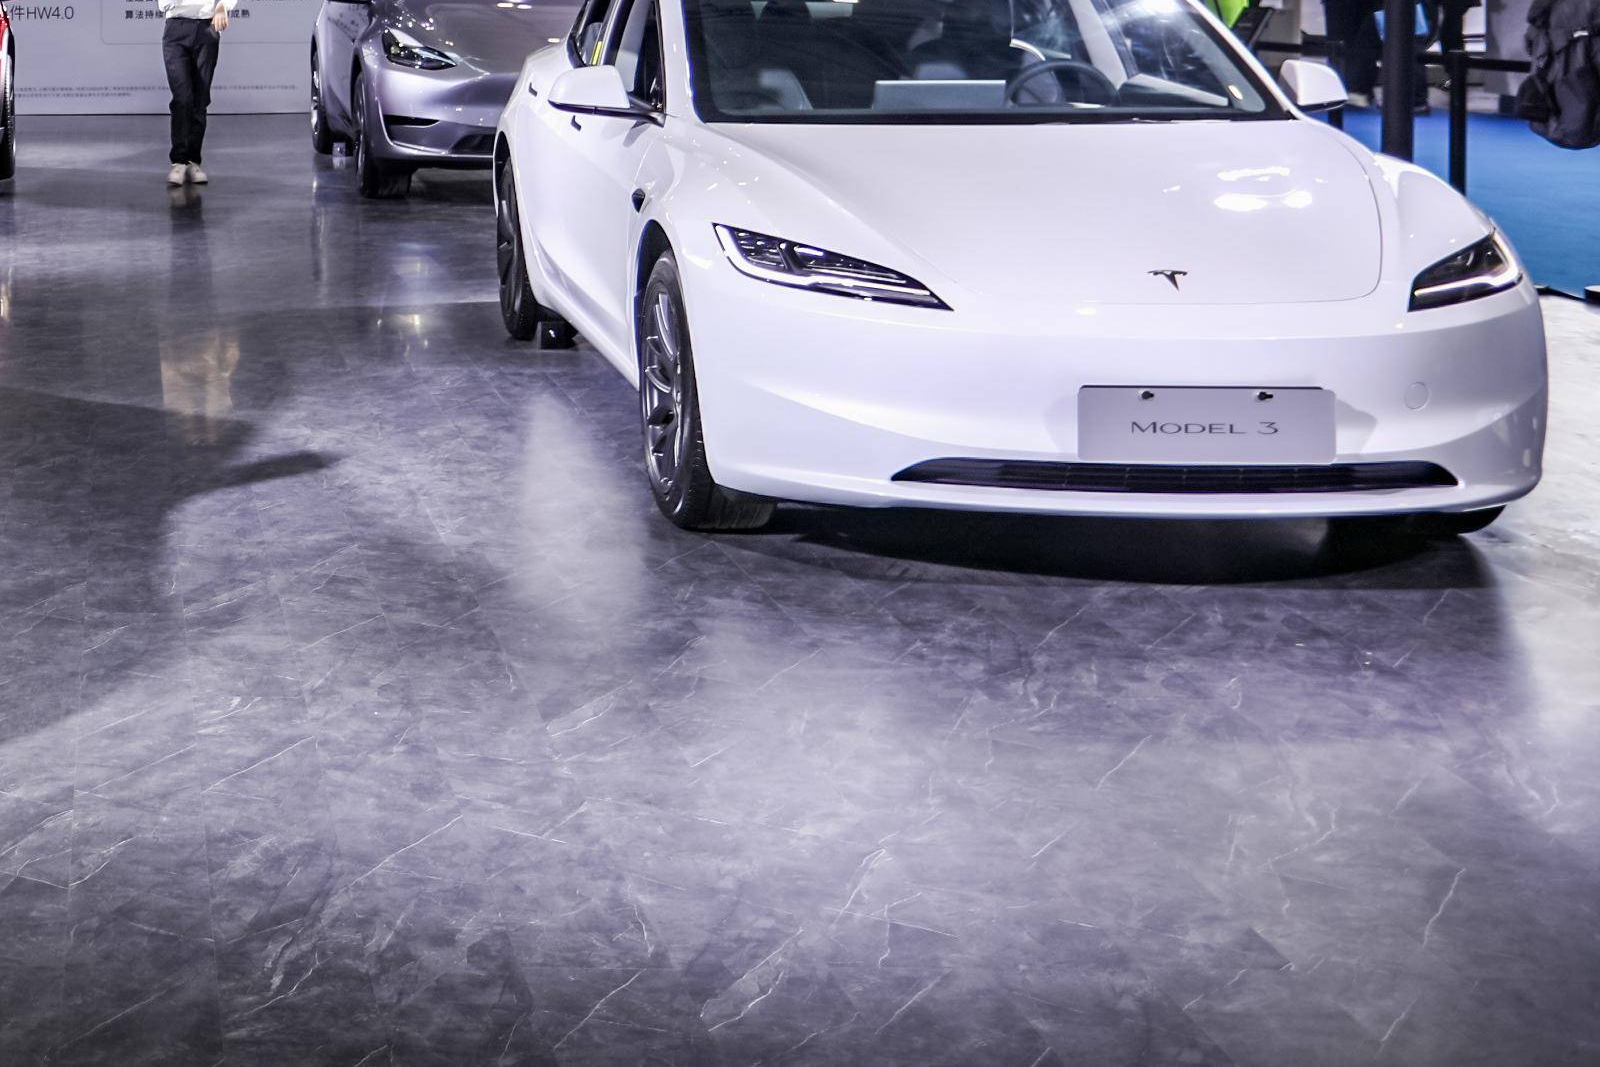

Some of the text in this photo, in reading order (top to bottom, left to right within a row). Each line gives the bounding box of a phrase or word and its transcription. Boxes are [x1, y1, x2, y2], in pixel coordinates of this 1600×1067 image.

[9, 5, 75, 21] 件HW4.0
[1131, 421, 1279, 435] MODEL 3
